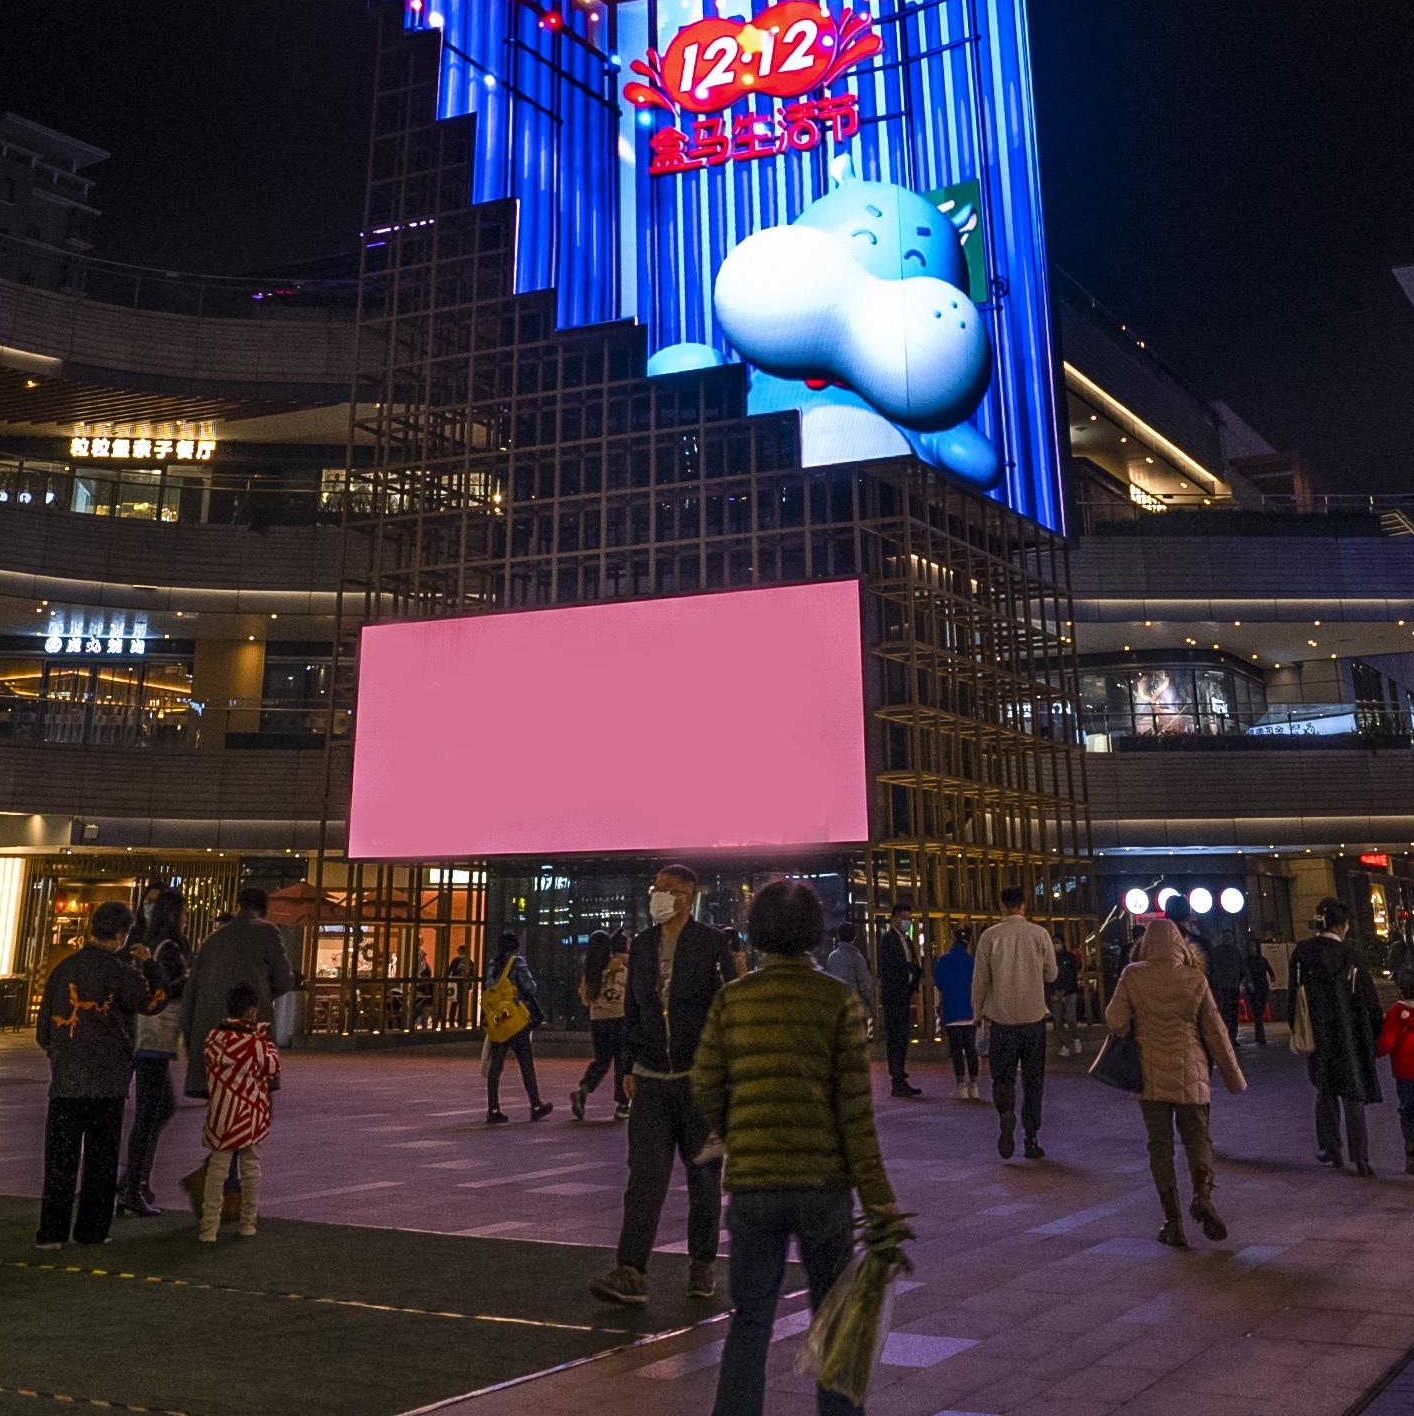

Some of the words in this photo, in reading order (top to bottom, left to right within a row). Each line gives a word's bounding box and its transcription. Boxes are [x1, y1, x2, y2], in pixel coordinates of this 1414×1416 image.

[649, 93, 861, 176] 盒马生活节
